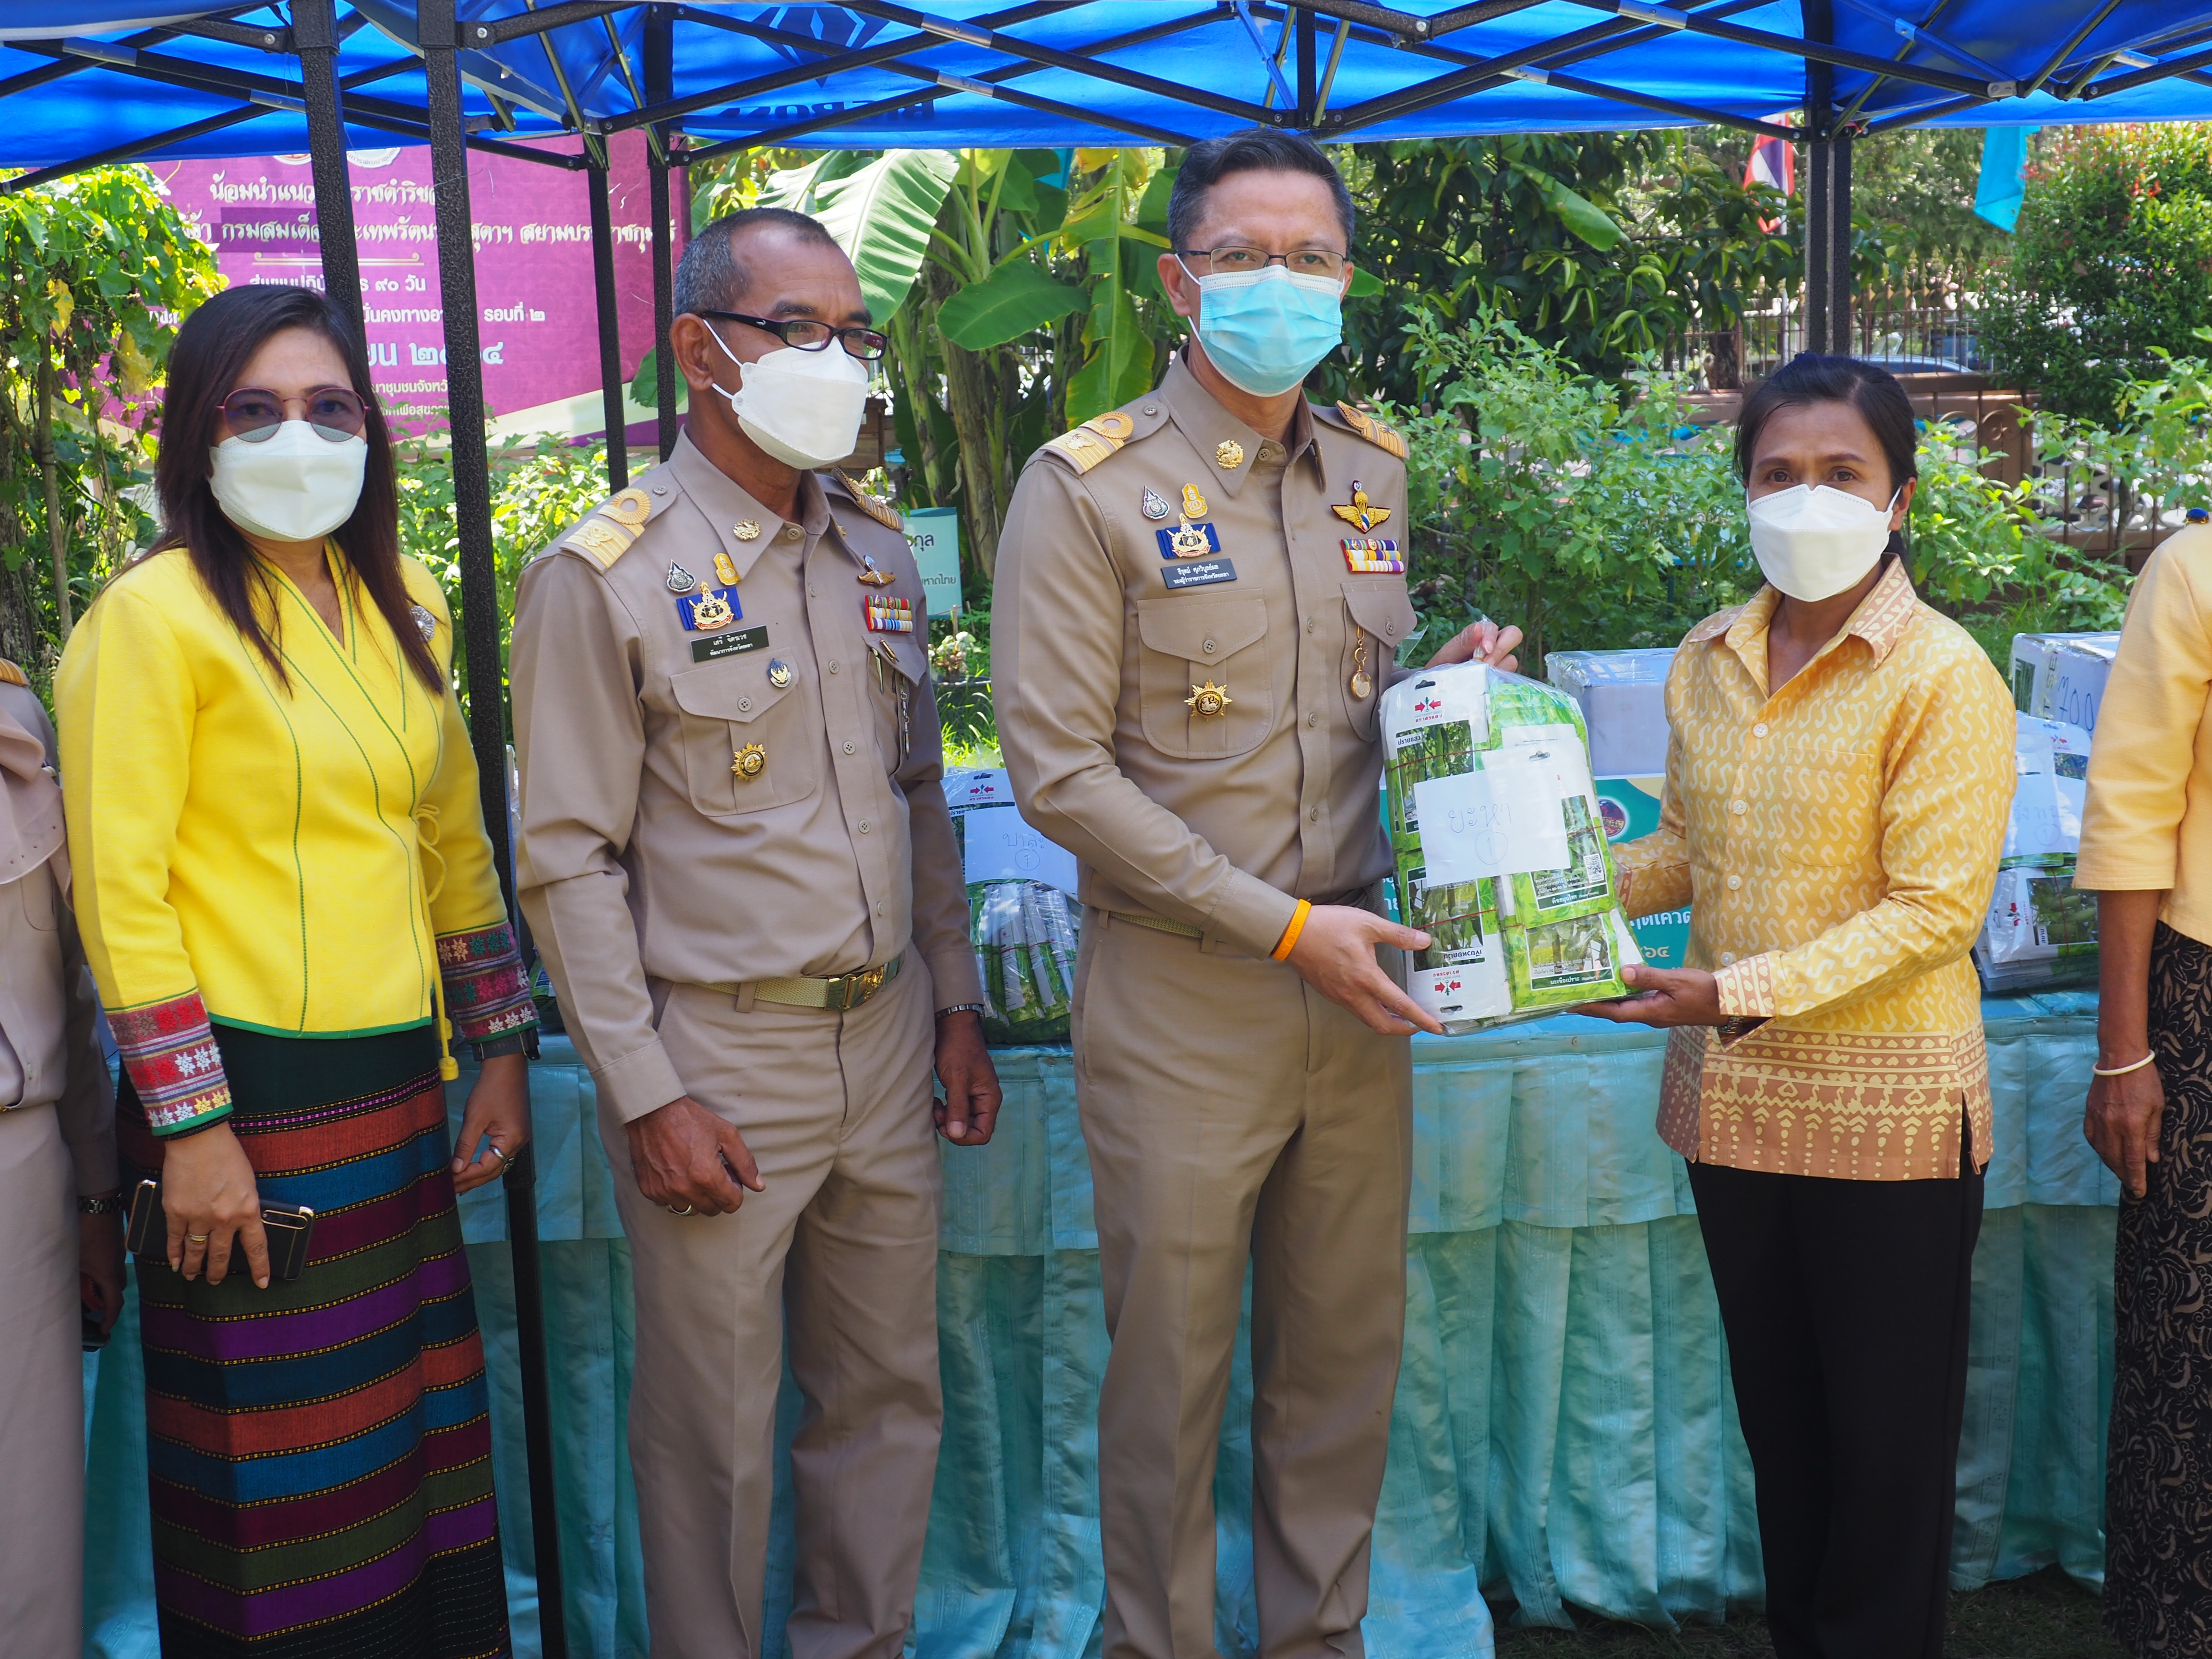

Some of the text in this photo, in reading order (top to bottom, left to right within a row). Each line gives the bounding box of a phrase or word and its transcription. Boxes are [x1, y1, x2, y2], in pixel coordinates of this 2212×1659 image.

[375, 277, 399, 291] ๙๐
[405, 275, 426, 291] วัน
[483, 301, 524, 322] รอบที่
[530, 309, 545, 322] ๒
[1642, 946, 1670, 958] ๖๔
